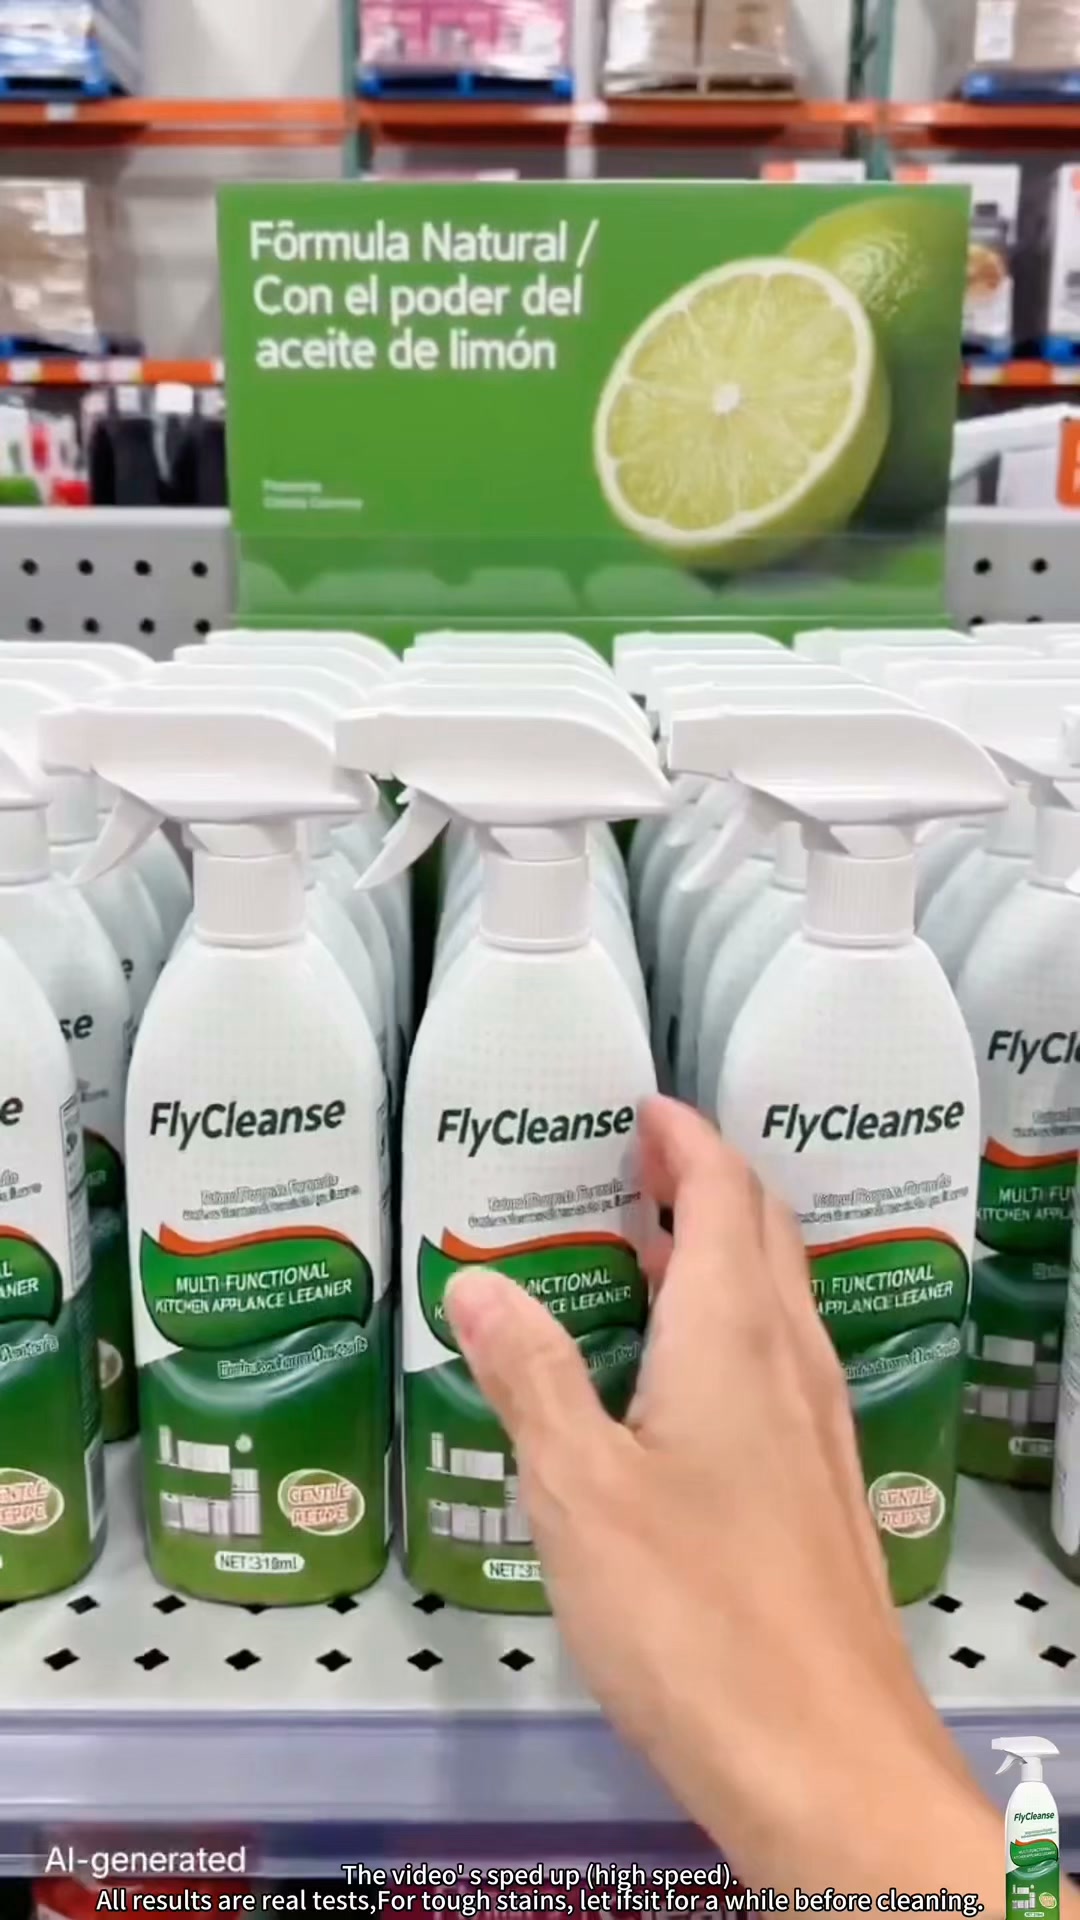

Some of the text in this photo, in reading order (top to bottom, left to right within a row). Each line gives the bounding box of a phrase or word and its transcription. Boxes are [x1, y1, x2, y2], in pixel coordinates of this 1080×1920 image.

[422, 220, 568, 263] Natural
[253, 273, 583, 326] Con el poder del
[256, 327, 557, 370] aceite de limón
[986, 1029, 1080, 1075] FlyCl
[149, 1100, 346, 1151] FlyCleanse
[437, 1105, 634, 1158] FlyCleanse
[761, 1100, 965, 1153] FlyCleanse
[176, 1261, 330, 1294] MULTI FUNCTIONAL
[526, 1267, 612, 1296] NCTIONAL
[831, 1263, 935, 1296] FUNCTIONAL
